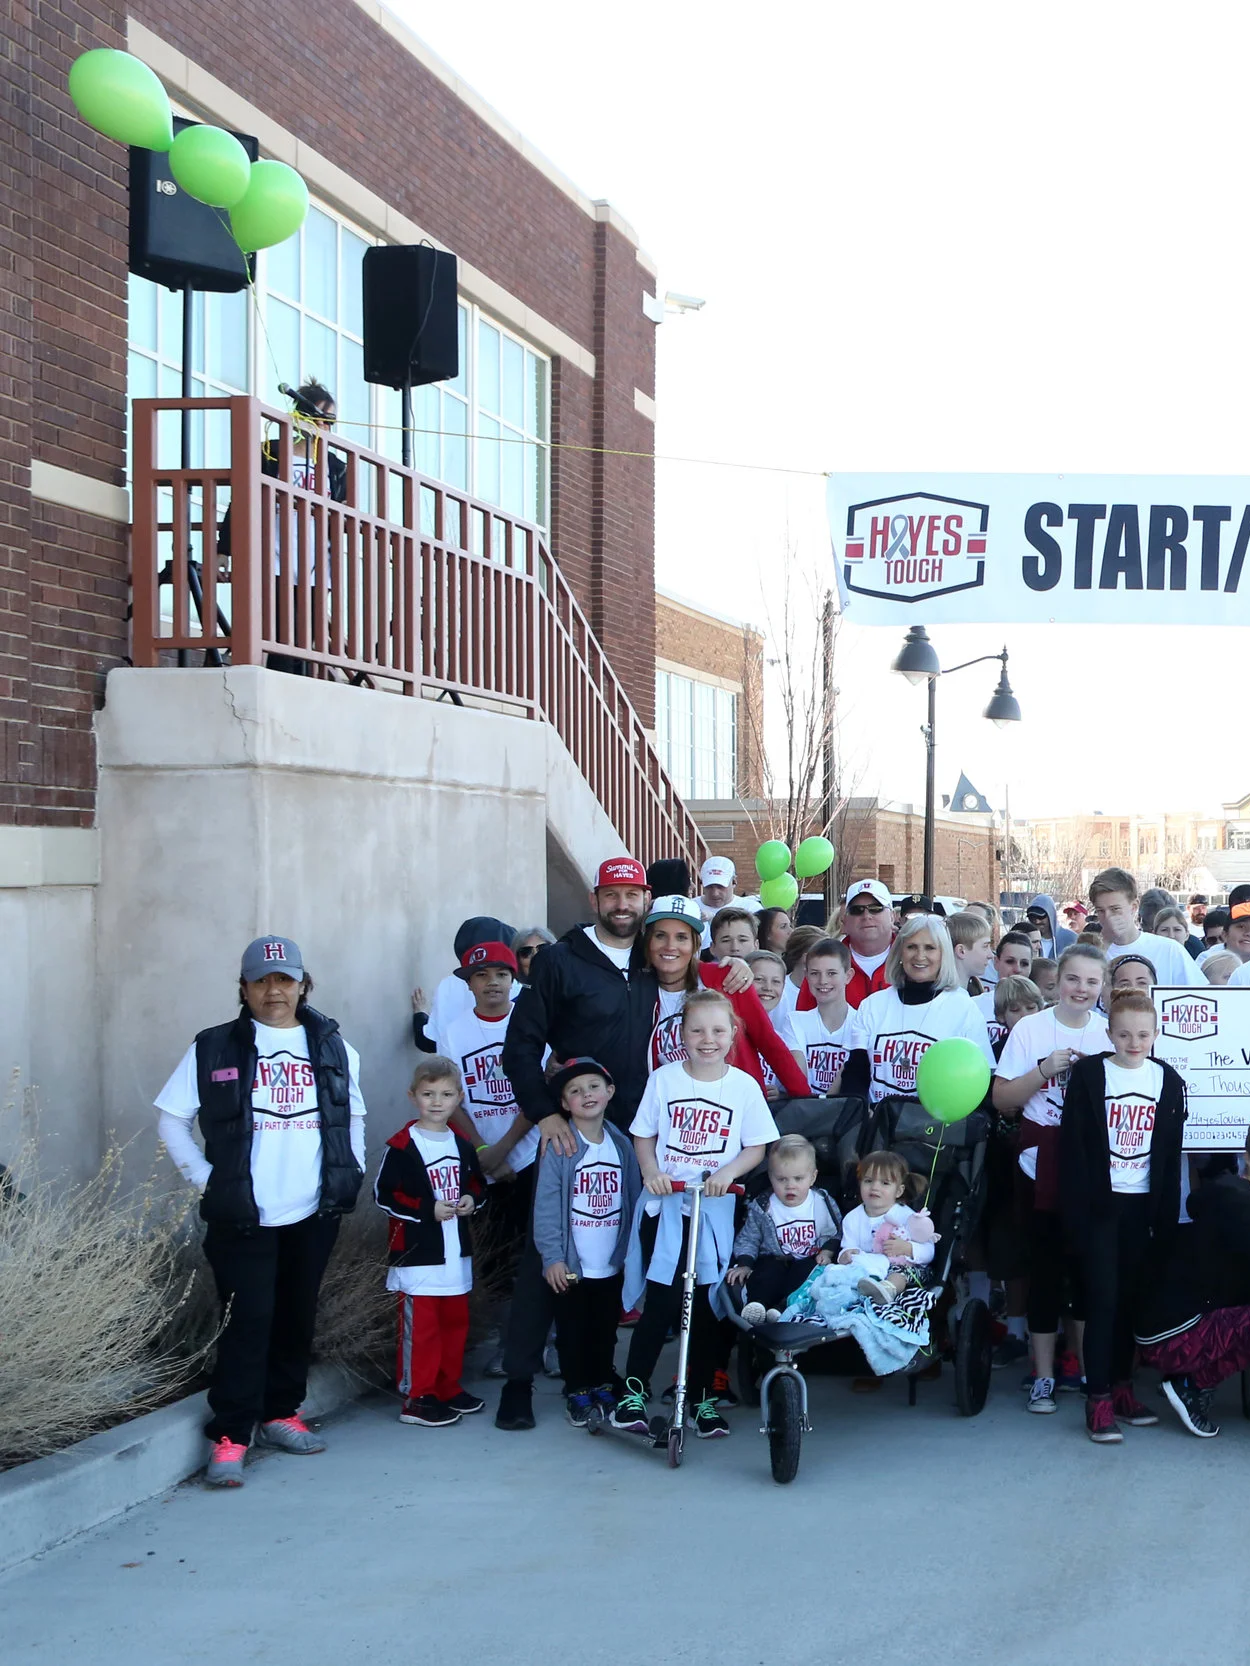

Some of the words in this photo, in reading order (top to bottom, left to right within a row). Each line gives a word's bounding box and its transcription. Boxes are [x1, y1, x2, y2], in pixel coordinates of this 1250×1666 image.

[885, 559, 943, 586] TOUGH
[263, 942, 287, 961] H
[1178, 1022, 1202, 1034] TOUGH
[1205, 1052, 1234, 1068] The
[816, 1070, 837, 1083] TOUG
[485, 1078, 512, 1094] TOUG
[474, 1110, 482, 1118] BE
[483, 1108, 498, 1118] PART
[500, 1107, 508, 1116] OF
[264, 1121, 281, 1130] PART
[282, 1120, 291, 1130] OF
[292, 1120, 304, 1130] THE
[680, 1130, 708, 1146] TOUGH
[1116, 1131, 1144, 1146] TOUGH
[692, 1158, 702, 1166] THE
[429, 1165, 460, 1190] HAYE
[588, 1194, 612, 1208] TOUGH
[682, 1291, 692, 1334] Razor
